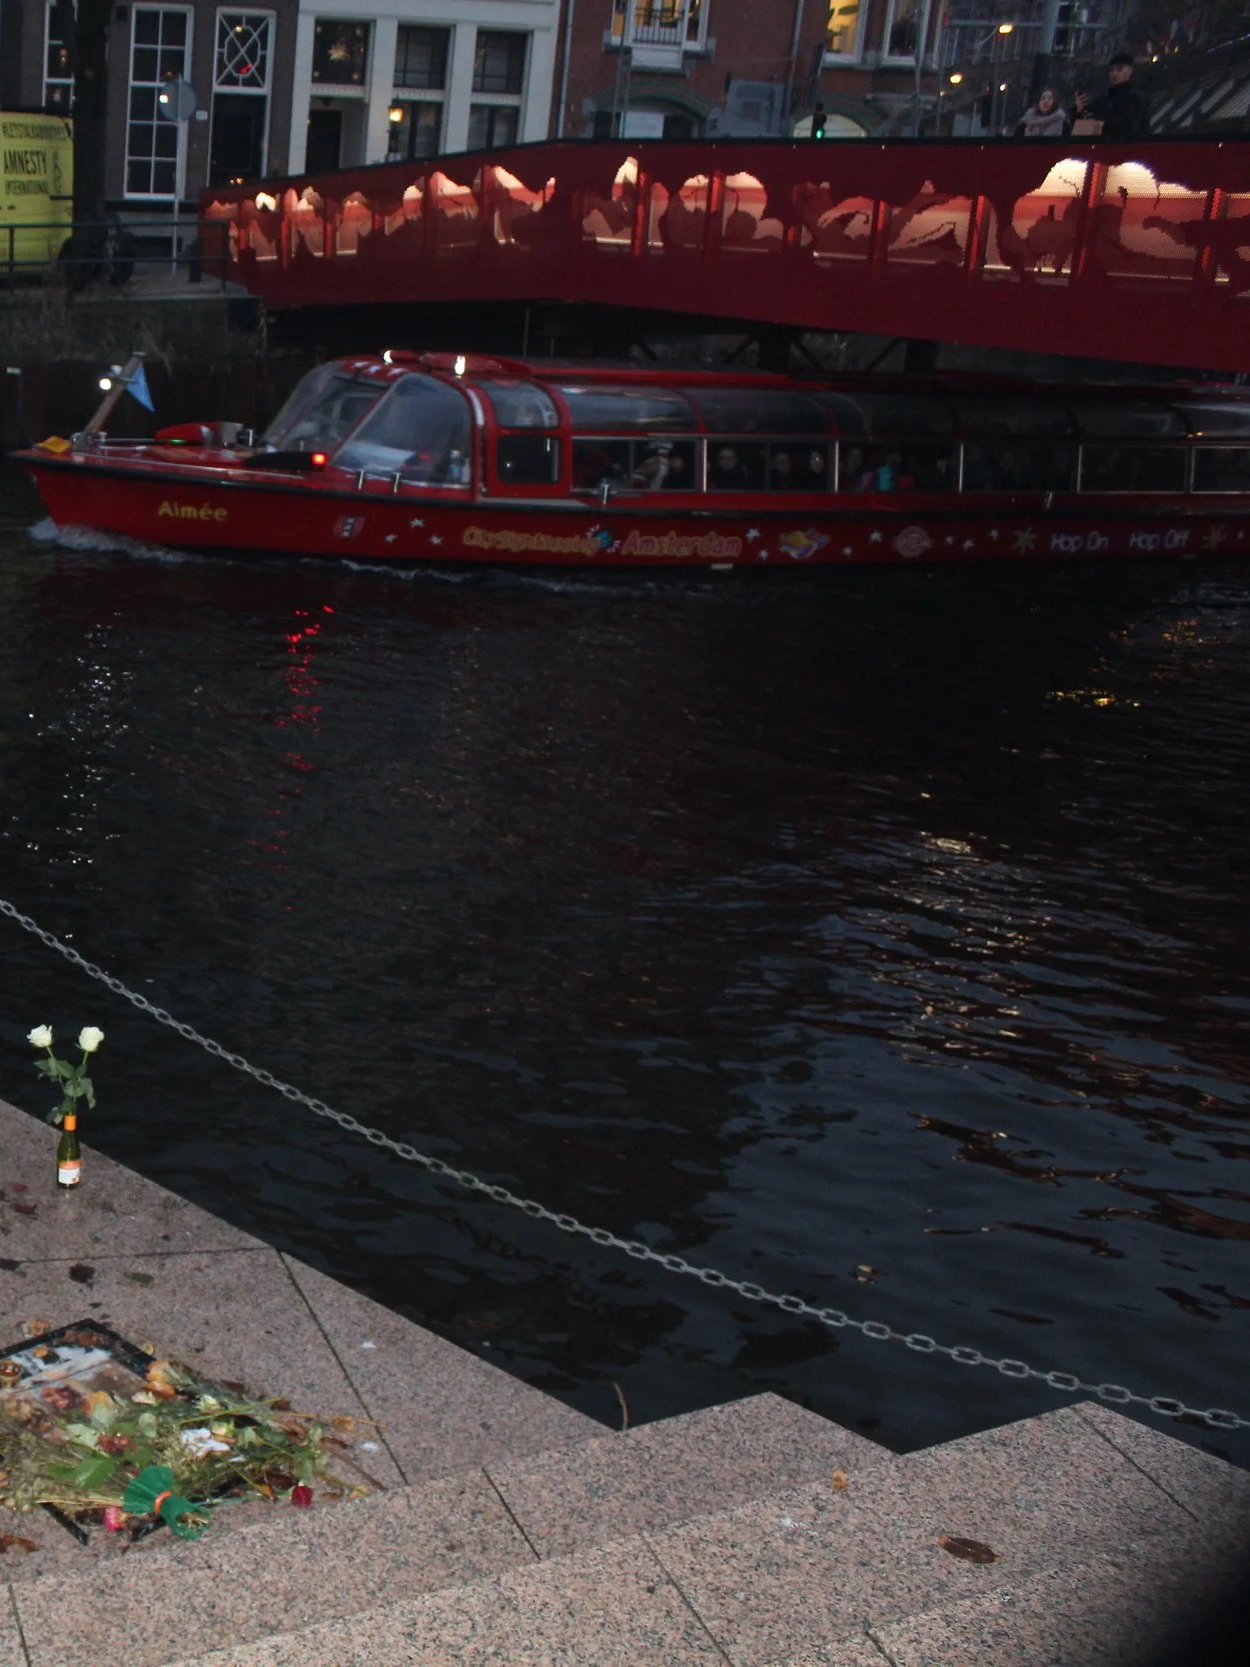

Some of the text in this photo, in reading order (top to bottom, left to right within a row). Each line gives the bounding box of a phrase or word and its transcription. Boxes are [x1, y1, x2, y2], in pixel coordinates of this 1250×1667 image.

[3, 149, 47, 175] AMNESTY
[4, 179, 49, 196] INTERNATIONAL
[157, 499, 228, 521] Aimée
[620, 528, 743, 557] Amsterdam
[1049, 527, 1193, 553] Hop On Hop Off
